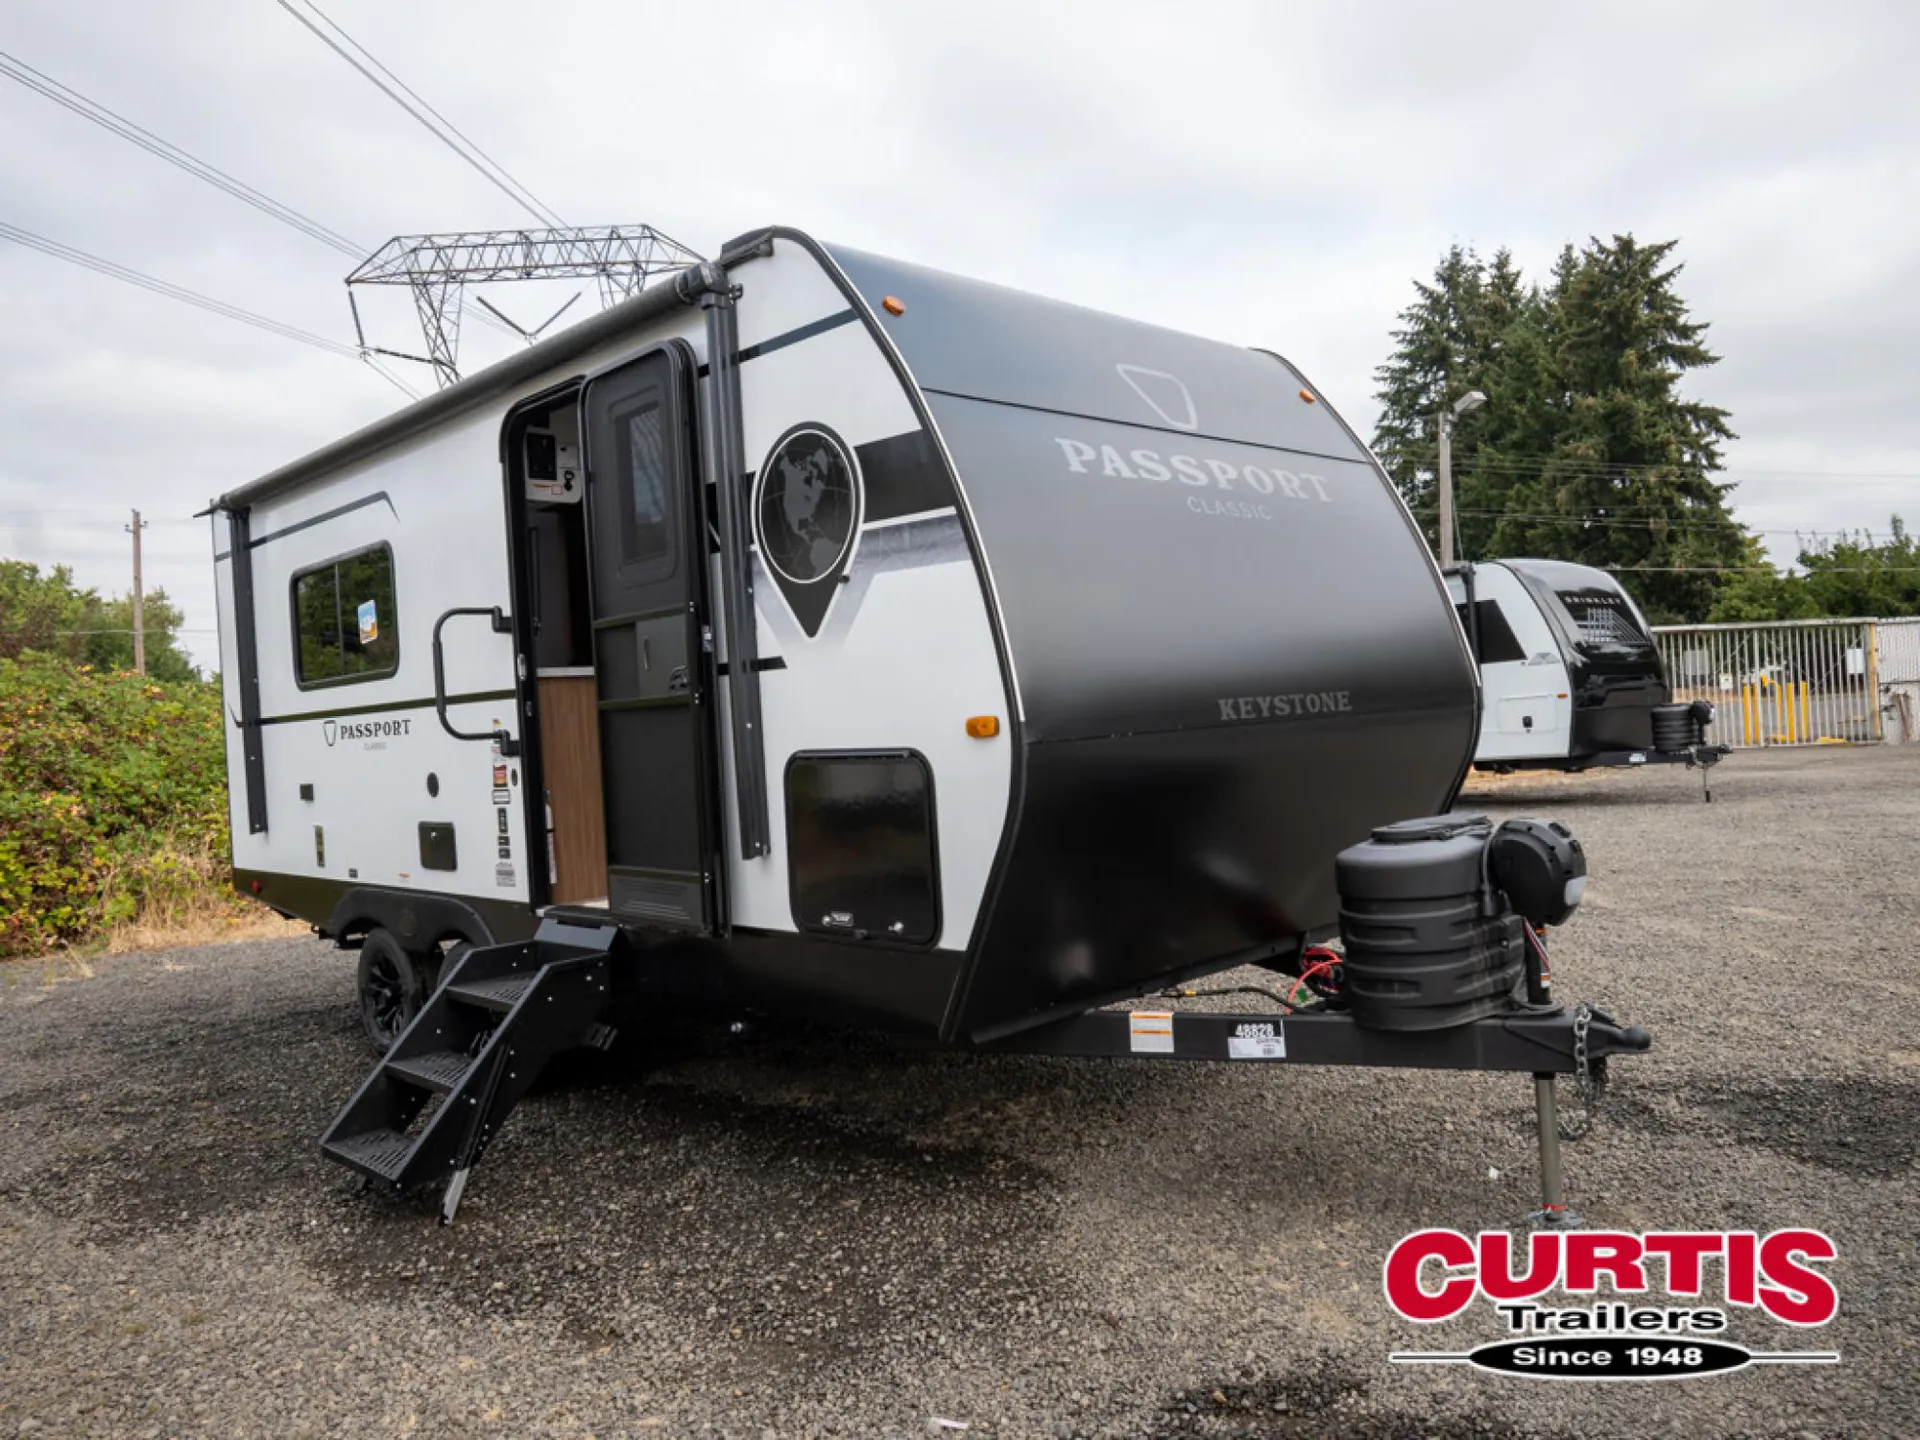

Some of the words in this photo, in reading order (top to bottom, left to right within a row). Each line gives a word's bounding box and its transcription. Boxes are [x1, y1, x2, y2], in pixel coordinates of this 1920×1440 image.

[1054, 437, 1332, 502] PASSPORT
[1186, 496, 1272, 520] CLASSIC
[1217, 691, 1353, 721] KEYSTONE
[340, 719, 411, 740] PASSPORT
